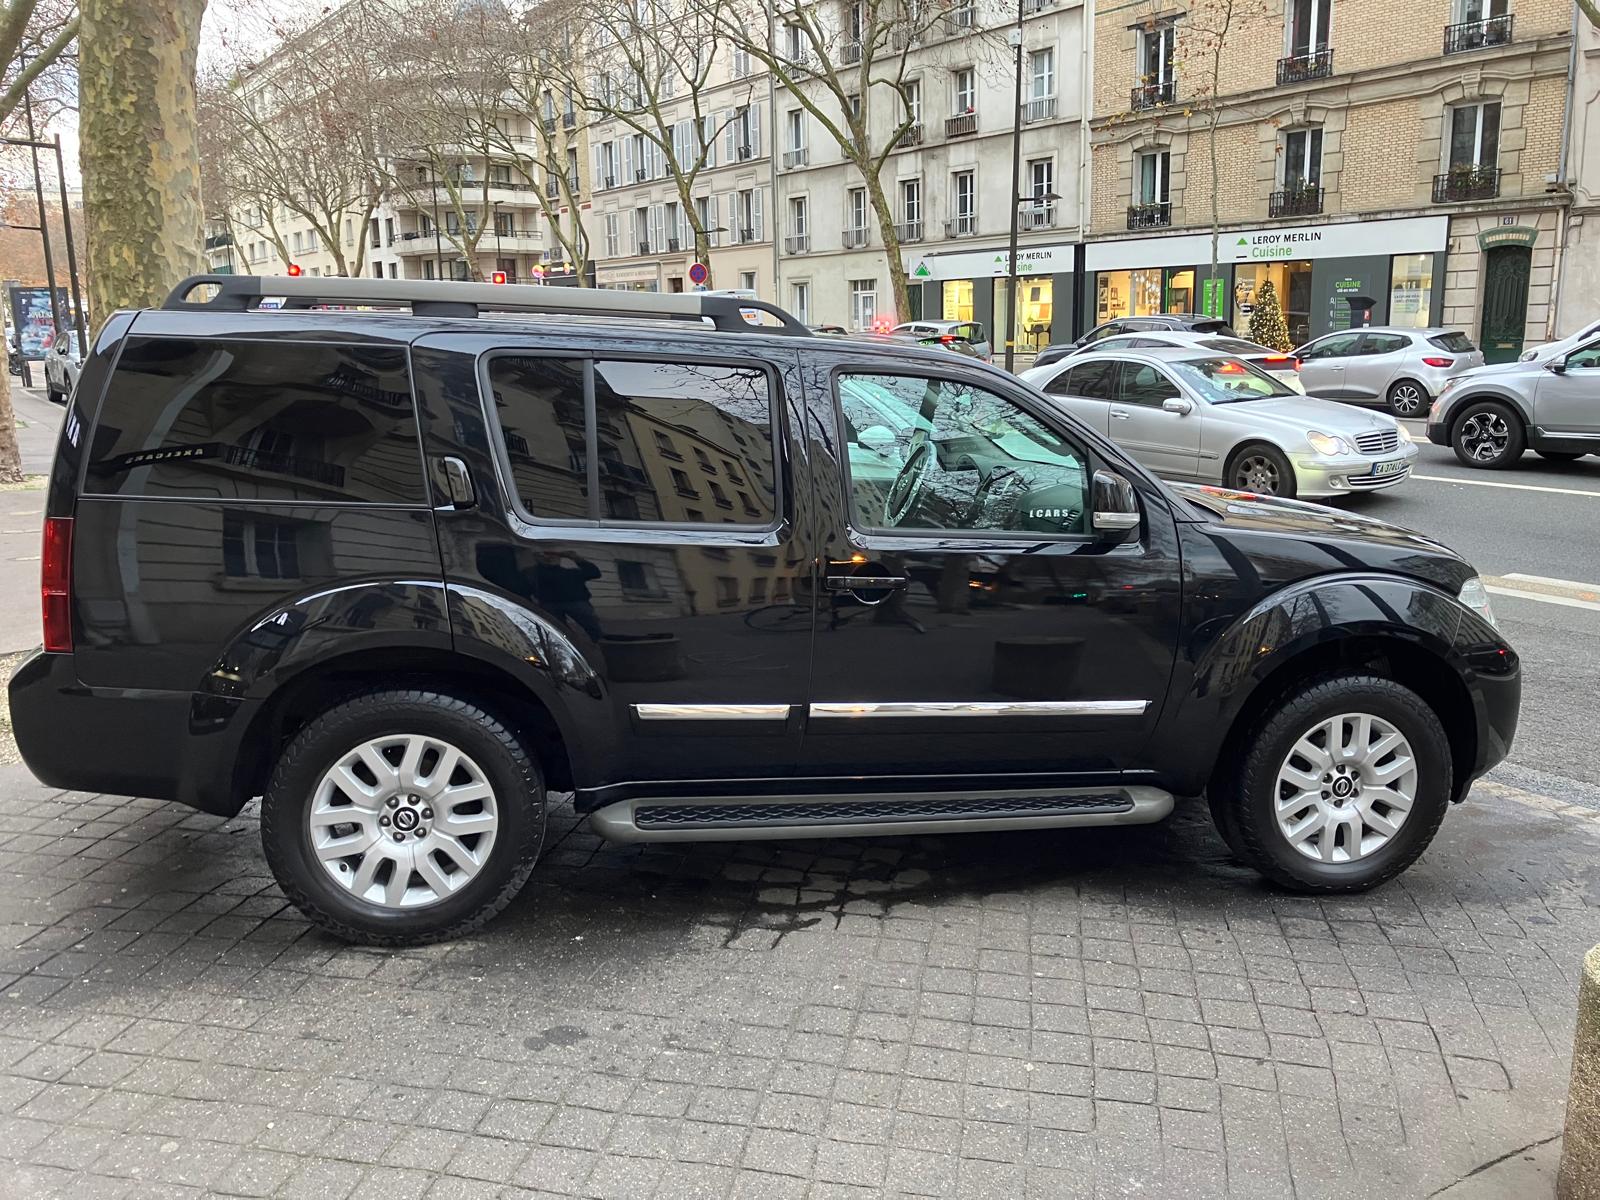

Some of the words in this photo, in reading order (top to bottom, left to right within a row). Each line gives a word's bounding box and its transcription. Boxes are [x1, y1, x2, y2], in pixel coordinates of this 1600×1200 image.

[1252, 234, 1281, 245] LEROY
[1283, 231, 1322, 243] MERLIN
[1004, 252, 1025, 262] LOY
[1025, 251, 1052, 260] MERLIN
[1252, 245, 1293, 258] Cuisine
[1004, 262, 1033, 273] Csine
